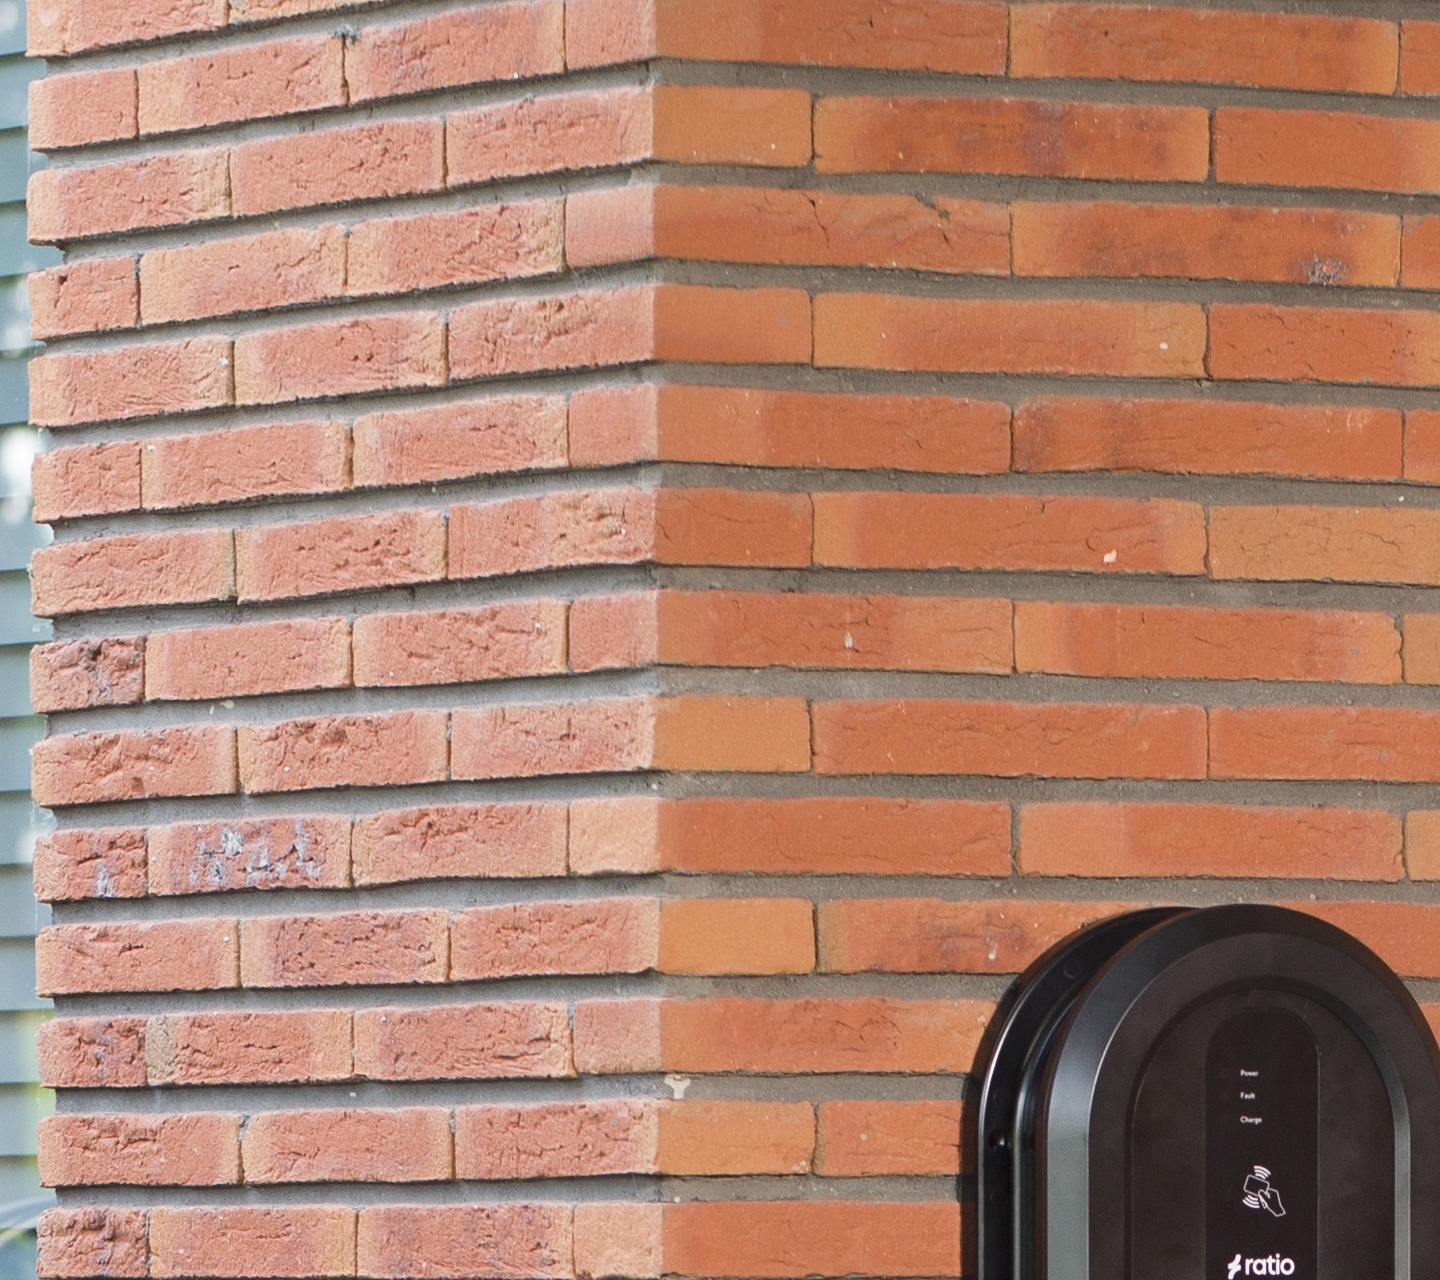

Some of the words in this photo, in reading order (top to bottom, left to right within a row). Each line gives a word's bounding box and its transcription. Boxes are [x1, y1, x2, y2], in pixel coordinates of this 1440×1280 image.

[1240, 1069, 1259, 1077] Power
[1240, 1091, 1256, 1099] Fault
[1240, 1115, 1263, 1125] Charge
[1244, 1253, 1296, 1276] ratio
